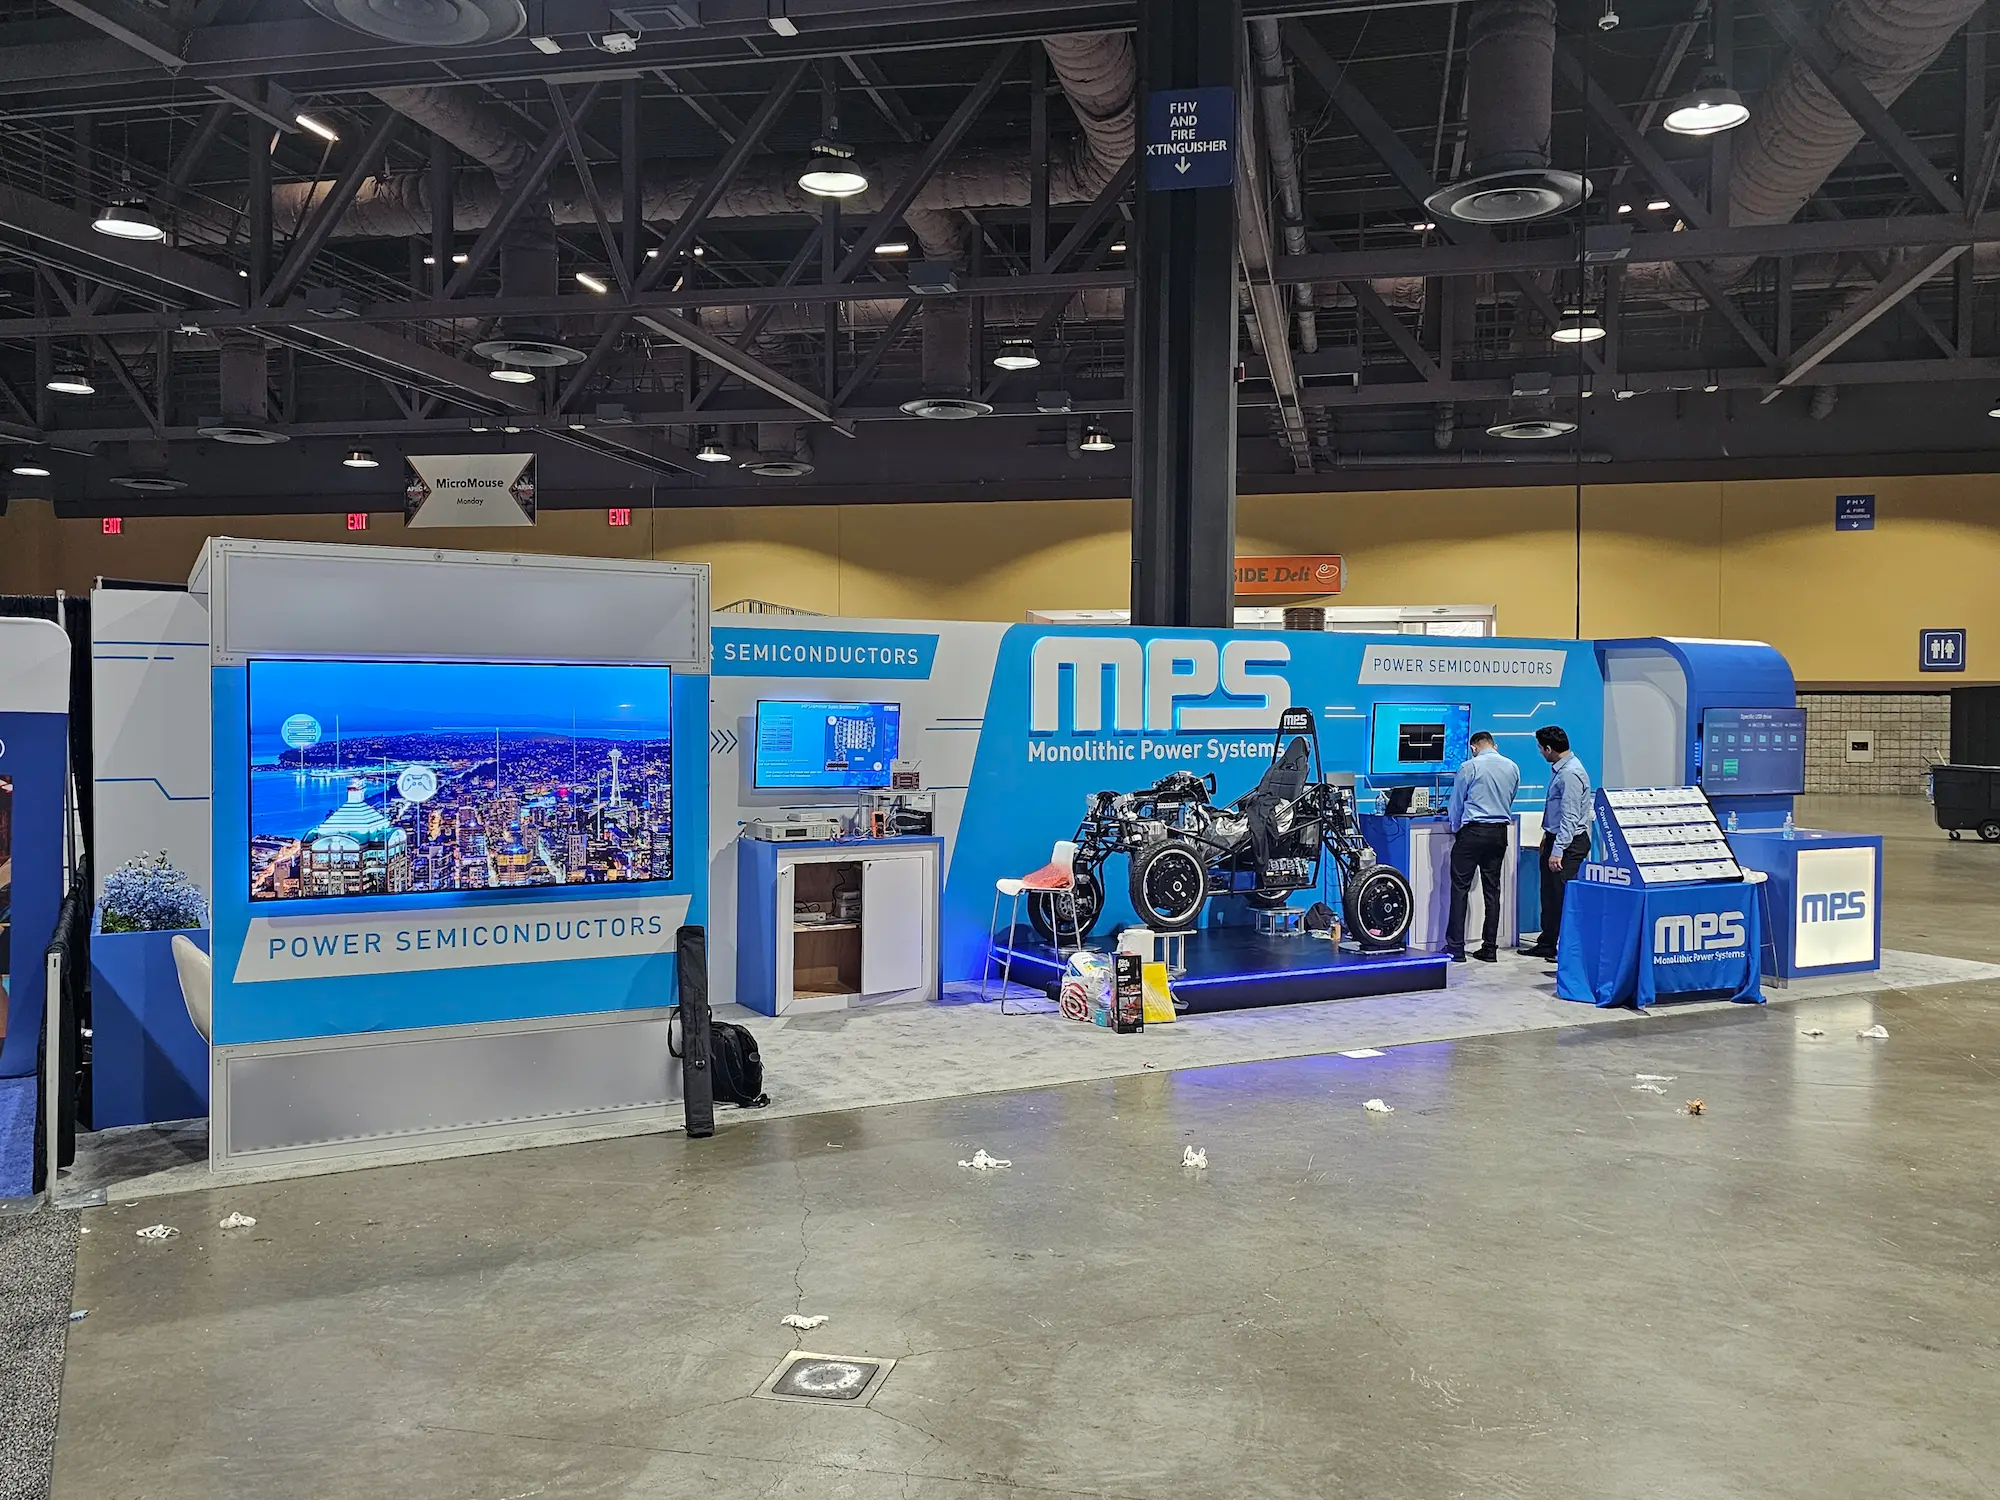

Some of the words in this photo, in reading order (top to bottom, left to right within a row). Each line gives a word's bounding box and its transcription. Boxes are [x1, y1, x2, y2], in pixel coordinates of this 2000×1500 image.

[1170, 102, 1197, 114] FHV
[1170, 115, 1198, 127] AND
[1171, 129, 1196, 140] FIRE
[1146, 140, 1227, 155] XTINGUISHER
[436, 478, 504, 488] MicroMouse
[456, 497, 484, 506] Monday
[348, 514, 367, 529] EXIT
[609, 509, 630, 525] EXIT
[103, 518, 122, 533] EXIT
[1273, 566, 1311, 582] Deli
[724, 643, 919, 665] SEMICONDUCTORS
[1374, 658, 1424, 672] POWER
[1429, 659, 1553, 675] SEMICONDUCTORS
[1030, 636, 1291, 732] MPS
[1283, 714, 1308, 726] MPS
[1028, 740, 1135, 762] Monolithic
[1141, 739, 1200, 760] Power
[1207, 738, 1285, 761] Systems
[1598, 805, 1610, 830] Power
[1606, 830, 1620, 863] Modules
[1585, 863, 1631, 886] MPS
[1801, 890, 1866, 923] MPS
[269, 932, 382, 959] POWER
[396, 915, 662, 951] SEMICONDUCTORS
[1654, 911, 1745, 954] MPS
[1653, 954, 1693, 965] Monolithic
[1693, 953, 1715, 963] Power
[1715, 950, 1746, 960] Systems
